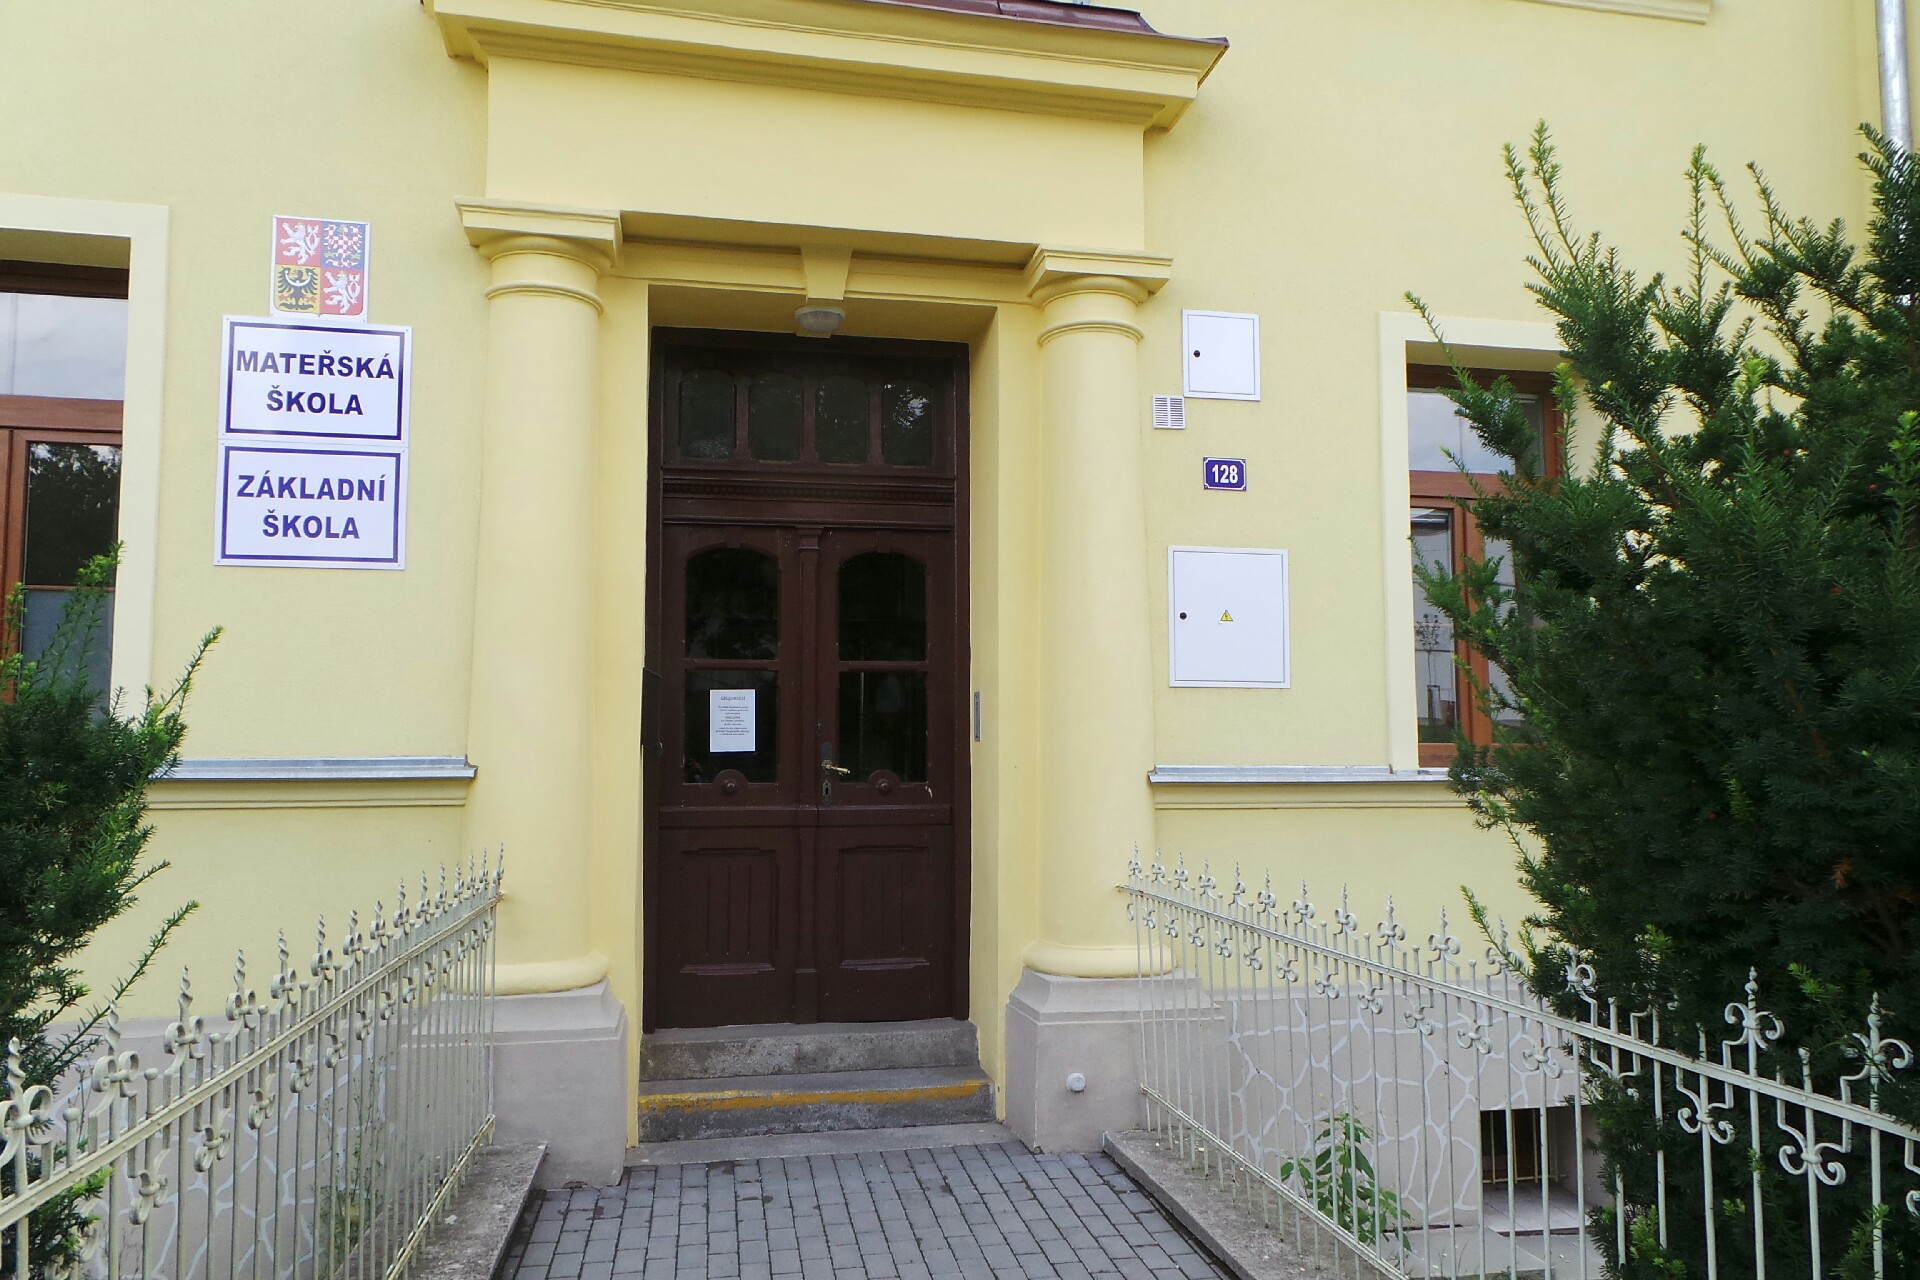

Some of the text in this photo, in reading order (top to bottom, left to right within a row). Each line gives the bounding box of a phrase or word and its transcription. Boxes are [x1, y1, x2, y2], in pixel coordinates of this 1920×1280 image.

[236, 349, 395, 380] MATEŘSKÁ
[266, 384, 364, 416] ŠKOLA
[237, 470, 386, 502] ZÁKLADNÍ
[1211, 464, 1239, 484] 128
[262, 509, 360, 540] ŠKOLA
